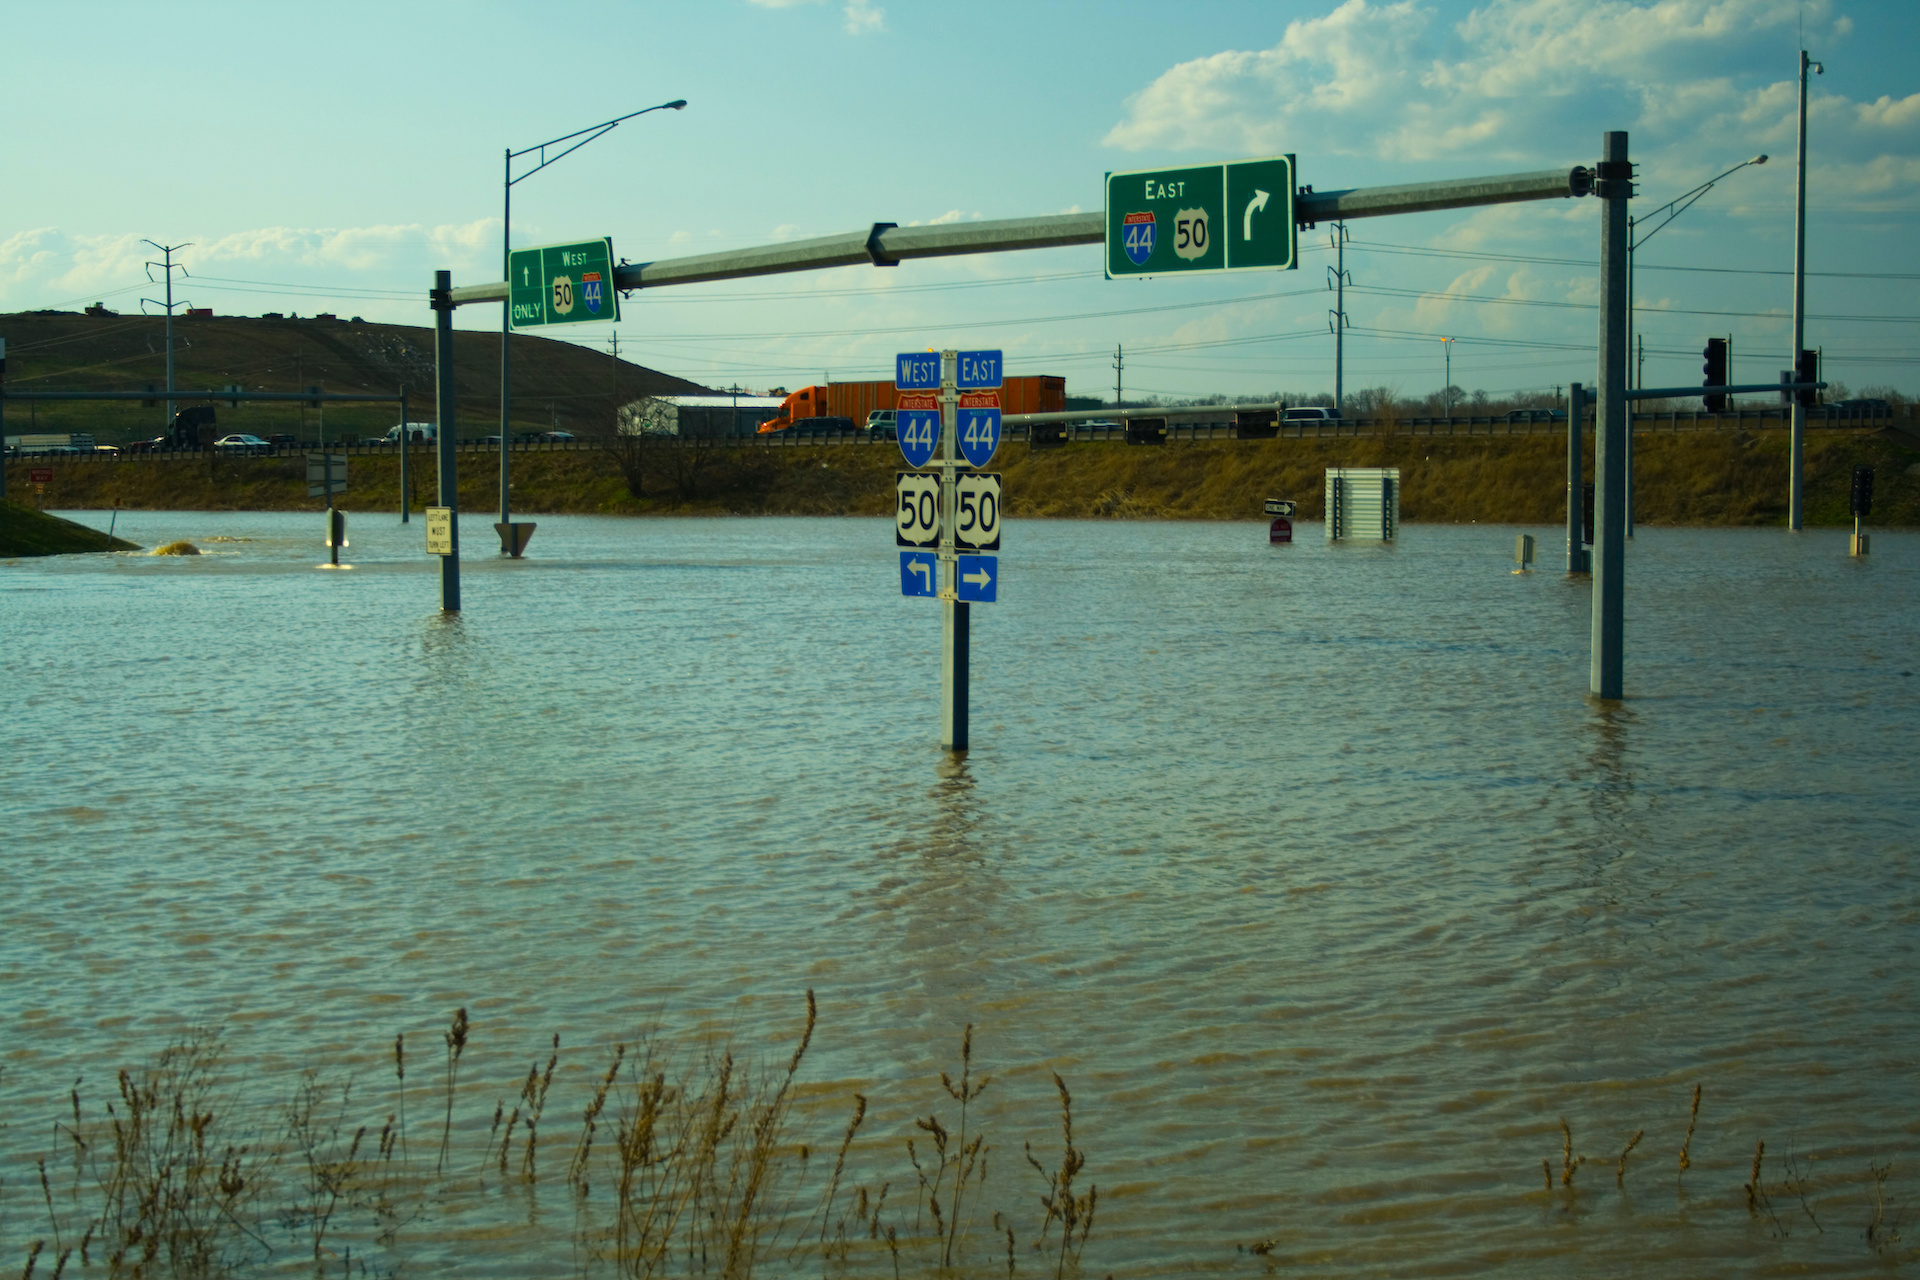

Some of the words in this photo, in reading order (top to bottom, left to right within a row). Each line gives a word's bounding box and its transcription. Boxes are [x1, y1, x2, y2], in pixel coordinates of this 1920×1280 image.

[1127, 214, 1152, 223] INTERSTATE
[1126, 225, 1153, 254] 44
[1178, 218, 1206, 249] 50
[554, 283, 572, 307] 50
[584, 282, 602, 305] 44
[515, 303, 541, 319] ONLY
[901, 360, 936, 382] WEST
[963, 358, 996, 381] EAST
[903, 399, 933, 409] INTERSTATE
[963, 397, 995, 407] INTERSTATE
[903, 419, 933, 451] 44
[964, 417, 994, 451] 44
[901, 490, 935, 531] 50
[960, 490, 996, 532] 50
[432, 527, 445, 535] MUST
